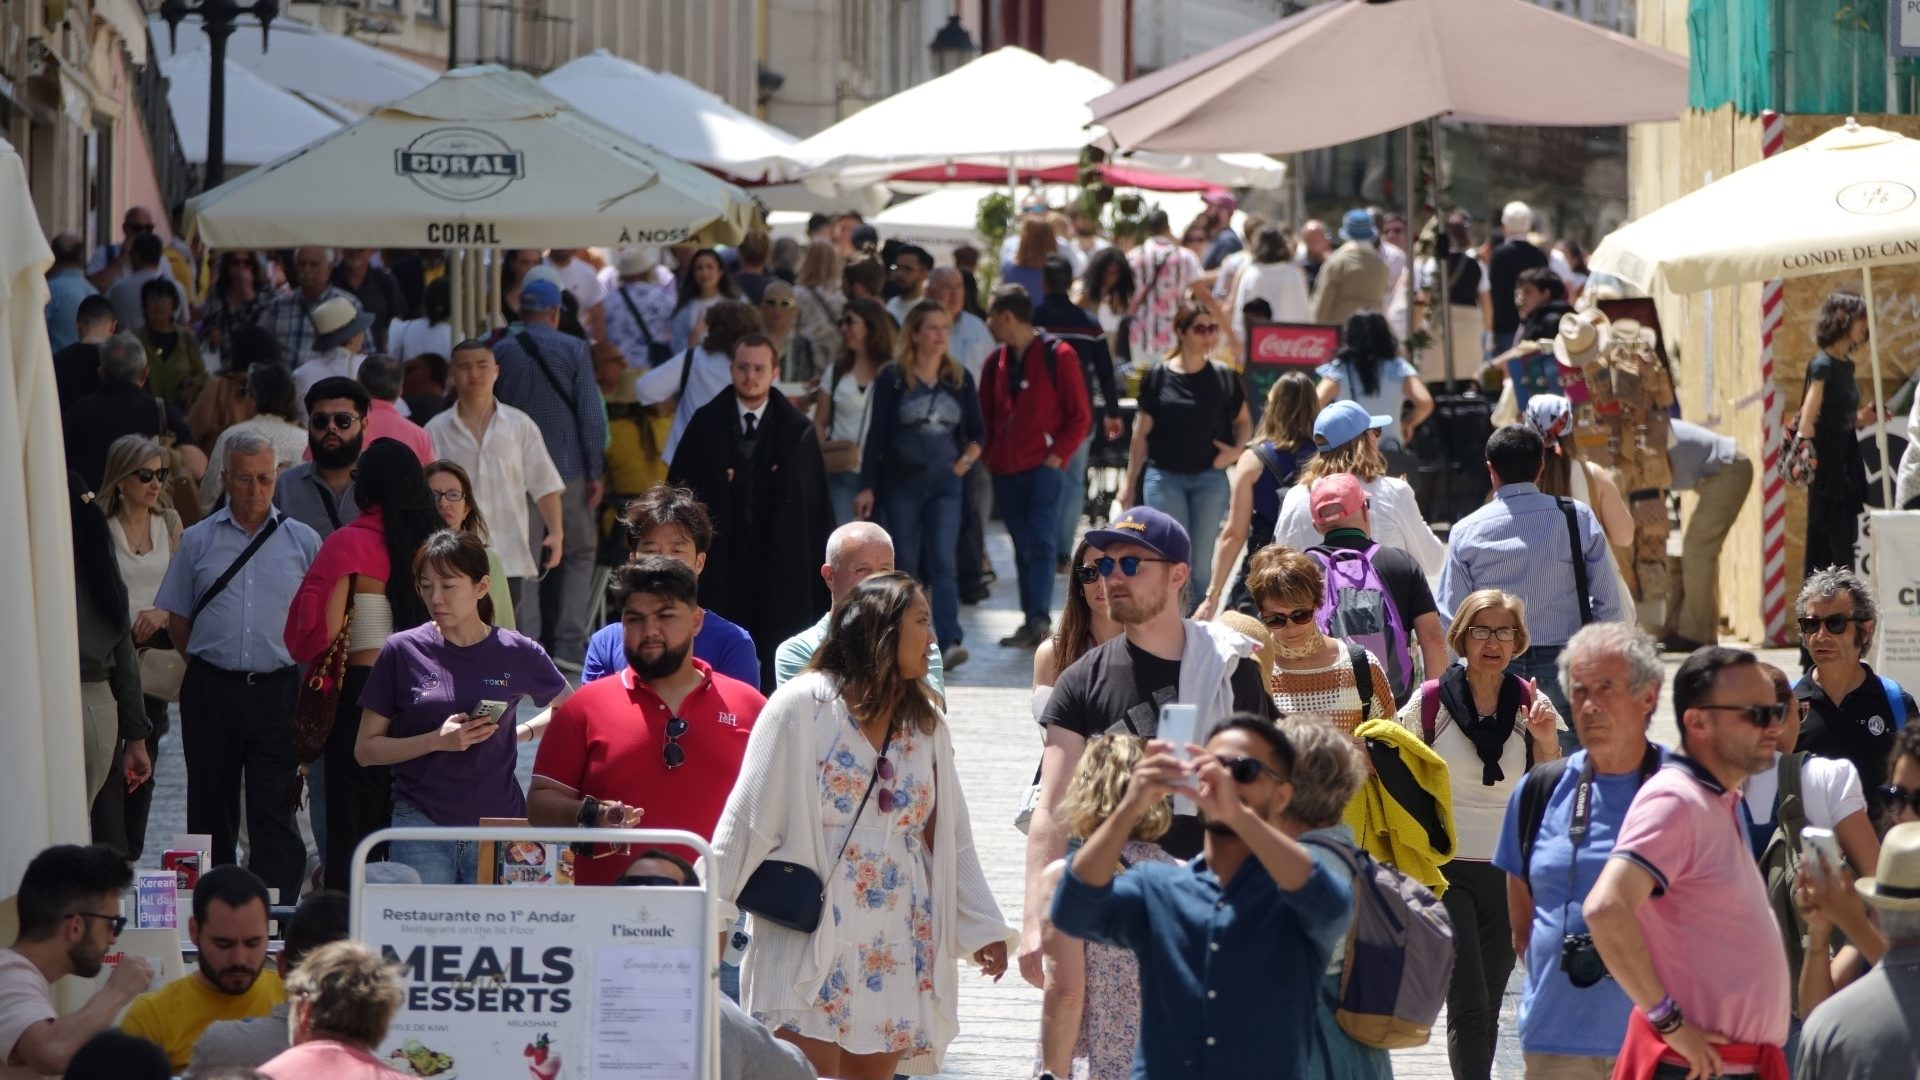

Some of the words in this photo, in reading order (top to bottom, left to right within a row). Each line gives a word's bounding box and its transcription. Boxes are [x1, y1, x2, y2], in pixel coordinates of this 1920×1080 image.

[410, 154, 511, 174] CORAL
[428, 222, 500, 244] CORAL
[1782, 247, 1847, 270] CONDE
[1852, 244, 1877, 261] DE
[1258, 333, 1328, 359] Coca-Cola
[1576, 783, 1587, 816] Canon
[140, 877, 175, 889] Korean
[140, 895, 153, 906] All
[156, 894, 176, 907] day
[141, 912, 176, 923] Brunch
[382, 908, 481, 922] Restaurante
[486, 912, 506, 922] no
[527, 910, 576, 923] Andar
[401, 924, 456, 935] Restaurant
[459, 926, 473, 934] on
[475, 925, 492, 935] the
[509, 925, 536, 935] Floor
[381, 944, 575, 985] MEALS
[408, 986, 572, 1014] ESSERTS
[412, 1023, 425, 1032] DE
[428, 1024, 449, 1032] KIWI
[508, 1019, 559, 1028] MILKSHAKE
